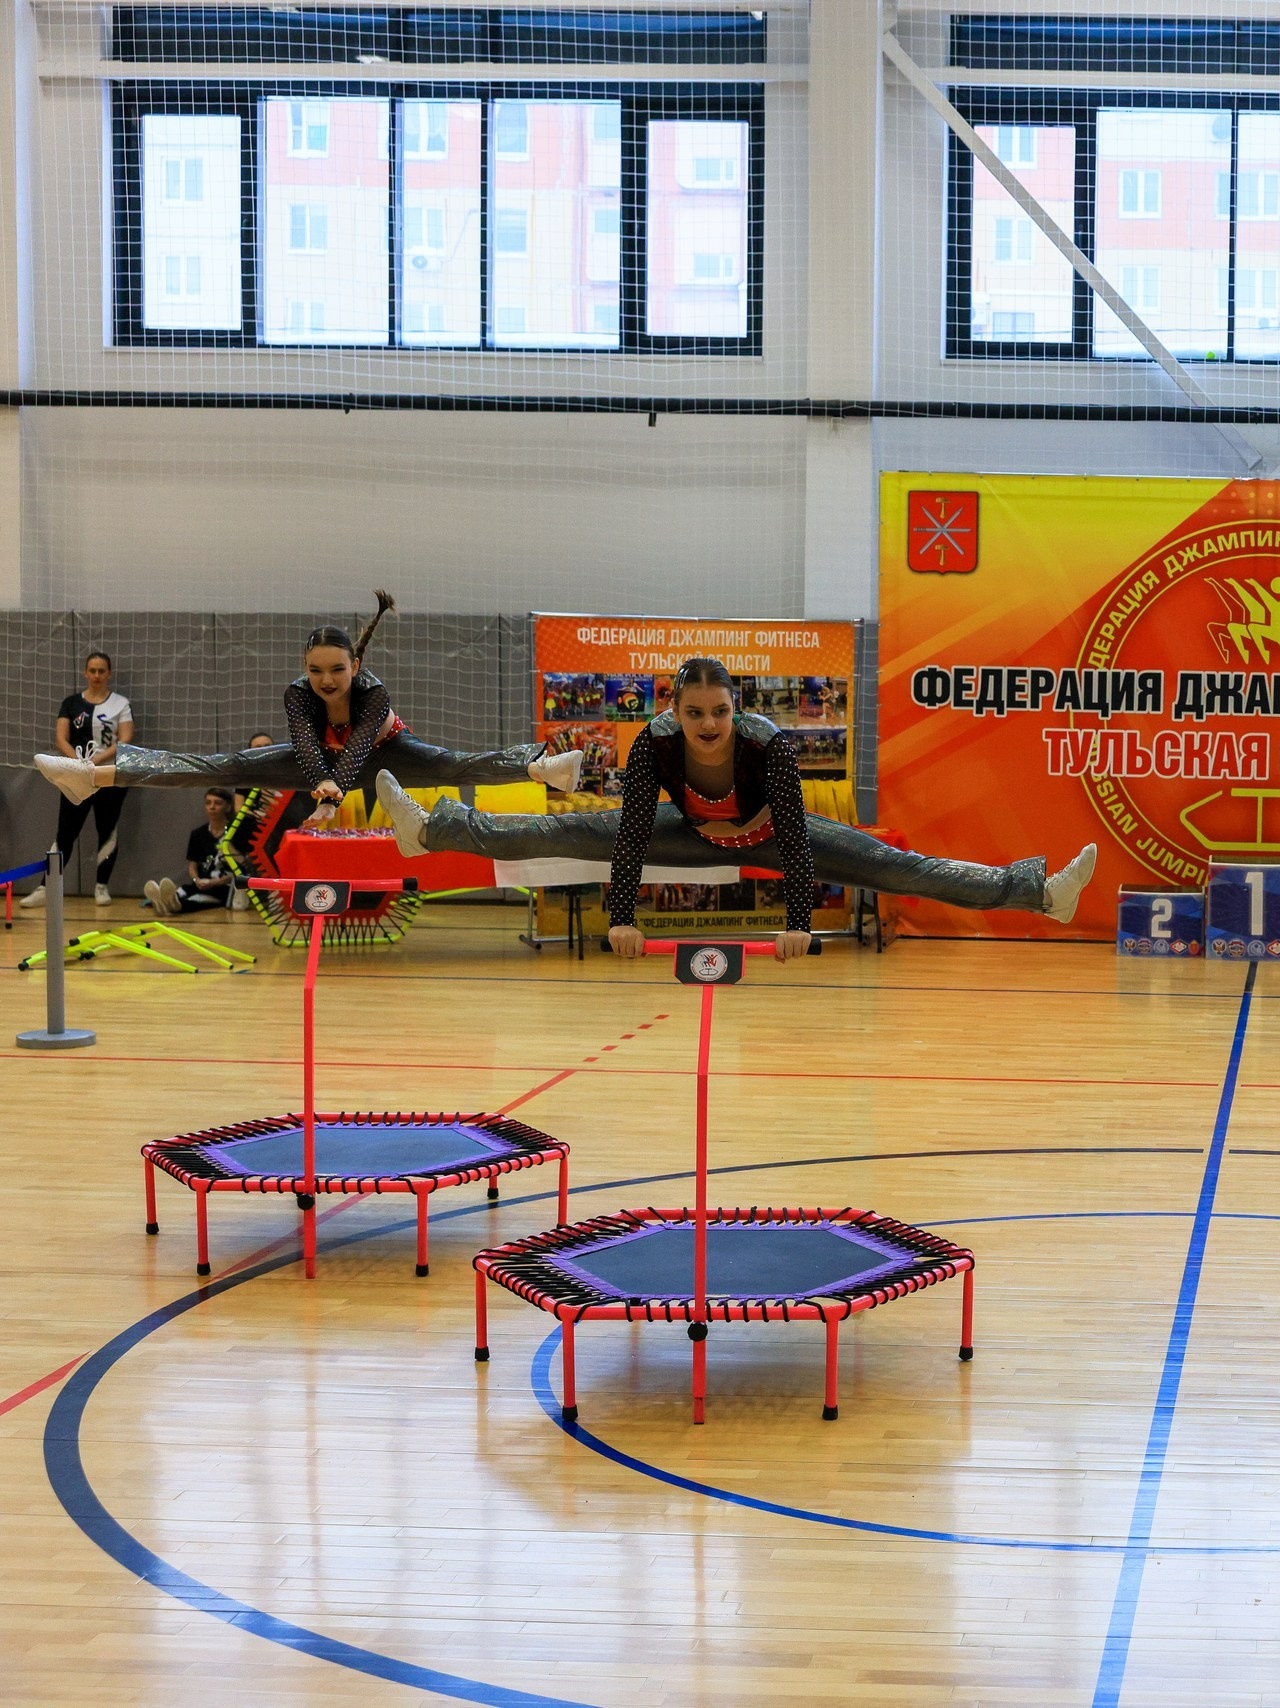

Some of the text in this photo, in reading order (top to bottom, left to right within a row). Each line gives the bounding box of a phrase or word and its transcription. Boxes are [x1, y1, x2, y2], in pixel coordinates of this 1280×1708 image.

[577, 627, 820, 649] ФЕДЕРАЦИЯ ДЖАМПИНГ ФИТНЕСА
[1087, 570, 1160, 669] ДЕРАЦИЯ
[911, 665, 1163, 720] ФЕДЕРАЦИЯ
[1043, 728, 1270, 781] ТУЛЬСКАЯ
[1136, 837, 1209, 887] JUMPI
[696, 916, 743, 929] ДЖАМПИНГ
[1151, 898, 1172, 937] 2
[1244, 871, 1264, 935] 1
